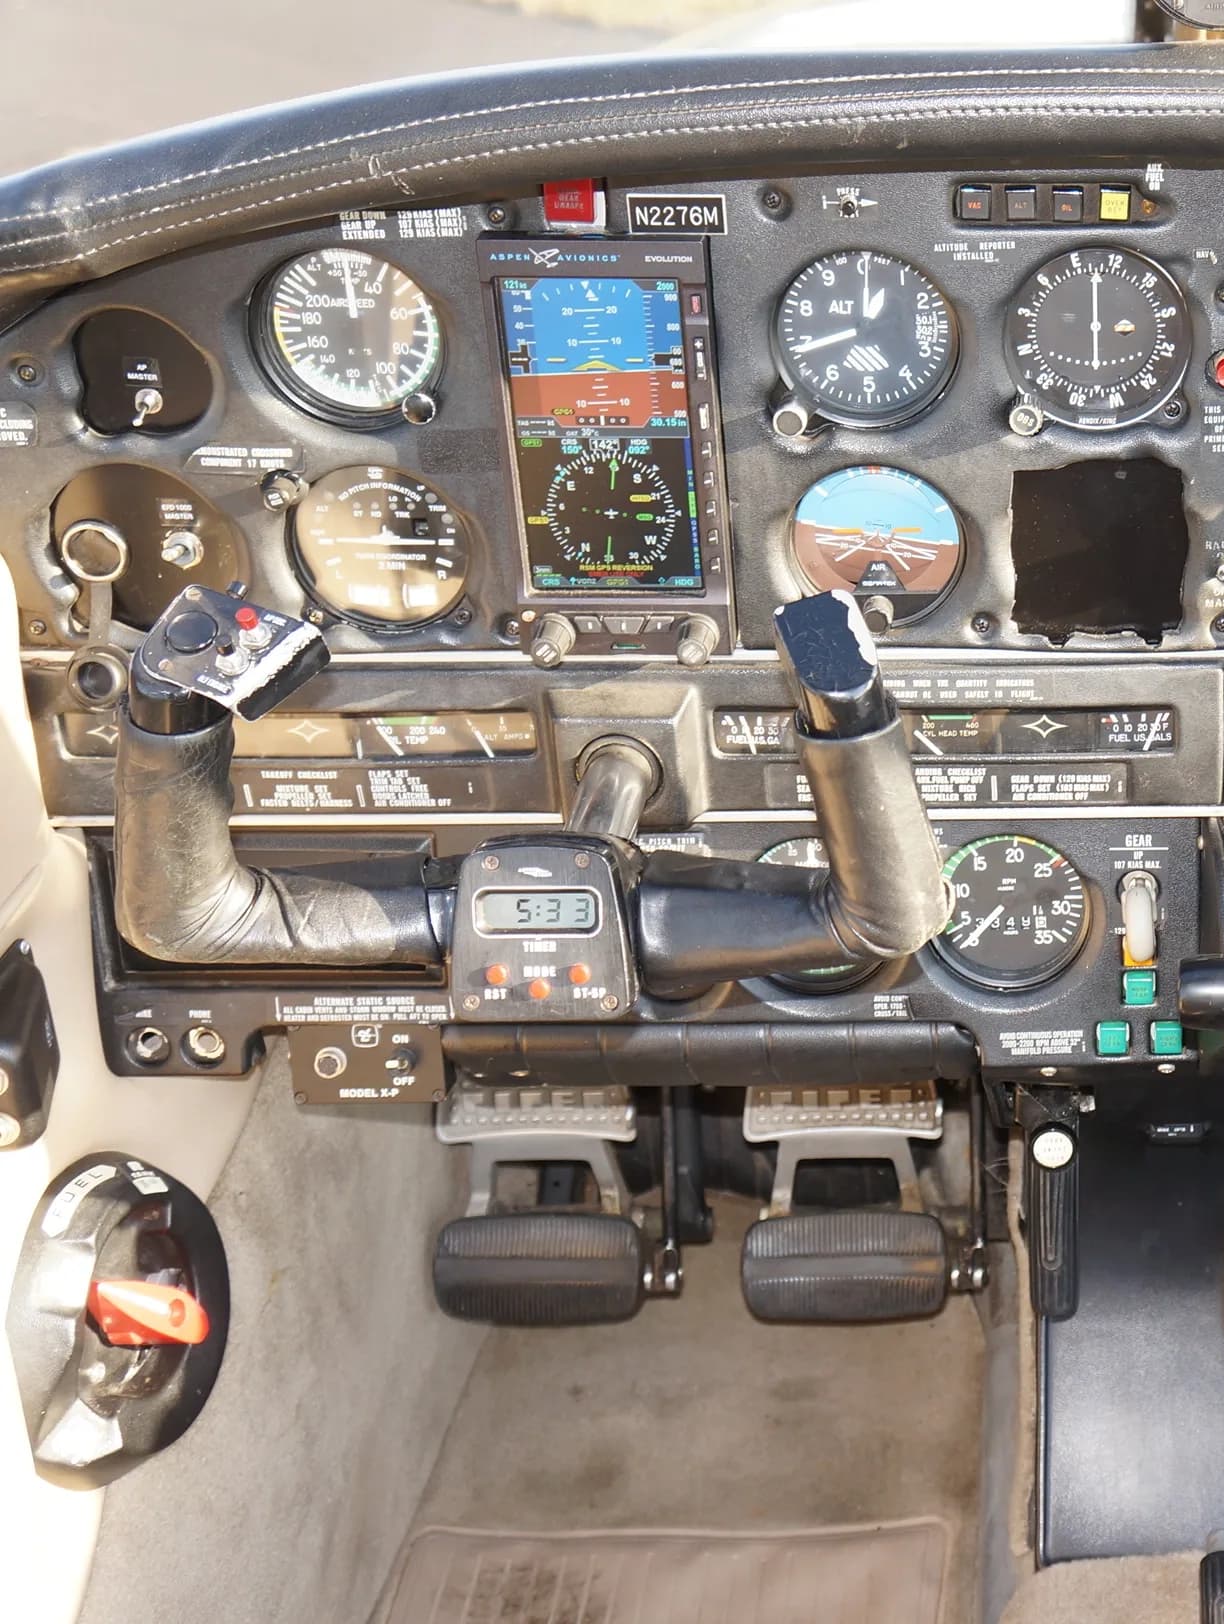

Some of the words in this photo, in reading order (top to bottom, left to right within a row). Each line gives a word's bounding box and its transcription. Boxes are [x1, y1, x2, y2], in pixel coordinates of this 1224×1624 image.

[1145, 173, 1164, 182] FUEL
[635, 206, 719, 226] N2276M
[934, 243, 968, 252] ALTITUDE
[980, 241, 1015, 250] REPORTER
[490, 253, 530, 262] ASPEN
[557, 254, 617, 262] AVIONICS
[645, 255, 693, 263] EVOLUTION
[953, 252, 994, 261] INSTALLED
[1070, 252, 1082, 268] E
[1108, 253, 1123, 269] 12
[822, 270, 835, 286] 9
[1141, 272, 1157, 289] 15
[365, 282, 382, 295] 40
[916, 292, 930, 309] 2
[799, 300, 813, 316] 8
[828, 301, 854, 314] ALT
[301, 311, 322, 325] 180
[390, 309, 408, 321] 60
[307, 335, 329, 349] 160
[392, 342, 409, 356] 80
[320, 355, 336, 364] 140
[346, 368, 361, 378] 120
[375, 361, 397, 375] 100
[826, 365, 839, 381] 6
[863, 377, 876, 393] 5
[1204, 405, 1221, 414] THIS
[409, 726, 426, 734] 200
[428, 726, 446, 735] 240
[404, 735, 429, 745] TEMP
[1125, 834, 1152, 847] GEAR
[1005, 848, 1024, 863] 20
[1133, 851, 1143, 860] UP
[973, 856, 987, 871] 15
[1114, 861, 1126, 869] 107
[1127, 861, 1143, 869] KIAS
[1144, 860, 1161, 869] MAX.
[1034, 863, 1053, 878] 25
[955, 883, 970, 898] 10
[1051, 901, 1071, 915] 30
[961, 911, 971, 925] 5
[1034, 930, 1053, 945] 35
[523, 941, 557, 952] TIMER
[523, 966, 557, 977] MODE
[484, 988, 507, 1000] RST
[314, 997, 354, 1006] ALTERNATE
[357, 997, 383, 1006] STATIC
[386, 996, 415, 1005] SOURCE
[392, 1034, 409, 1044] ON
[1011, 1047, 1041, 1056] MANIFOLD
[1042, 1046, 1072, 1055] PRESSURE
[393, 1076, 415, 1086] OFF
[340, 1088, 378, 1098] MODEL
[381, 1088, 399, 1097] X-P
[769, 1088, 914, 1110] PIPER
